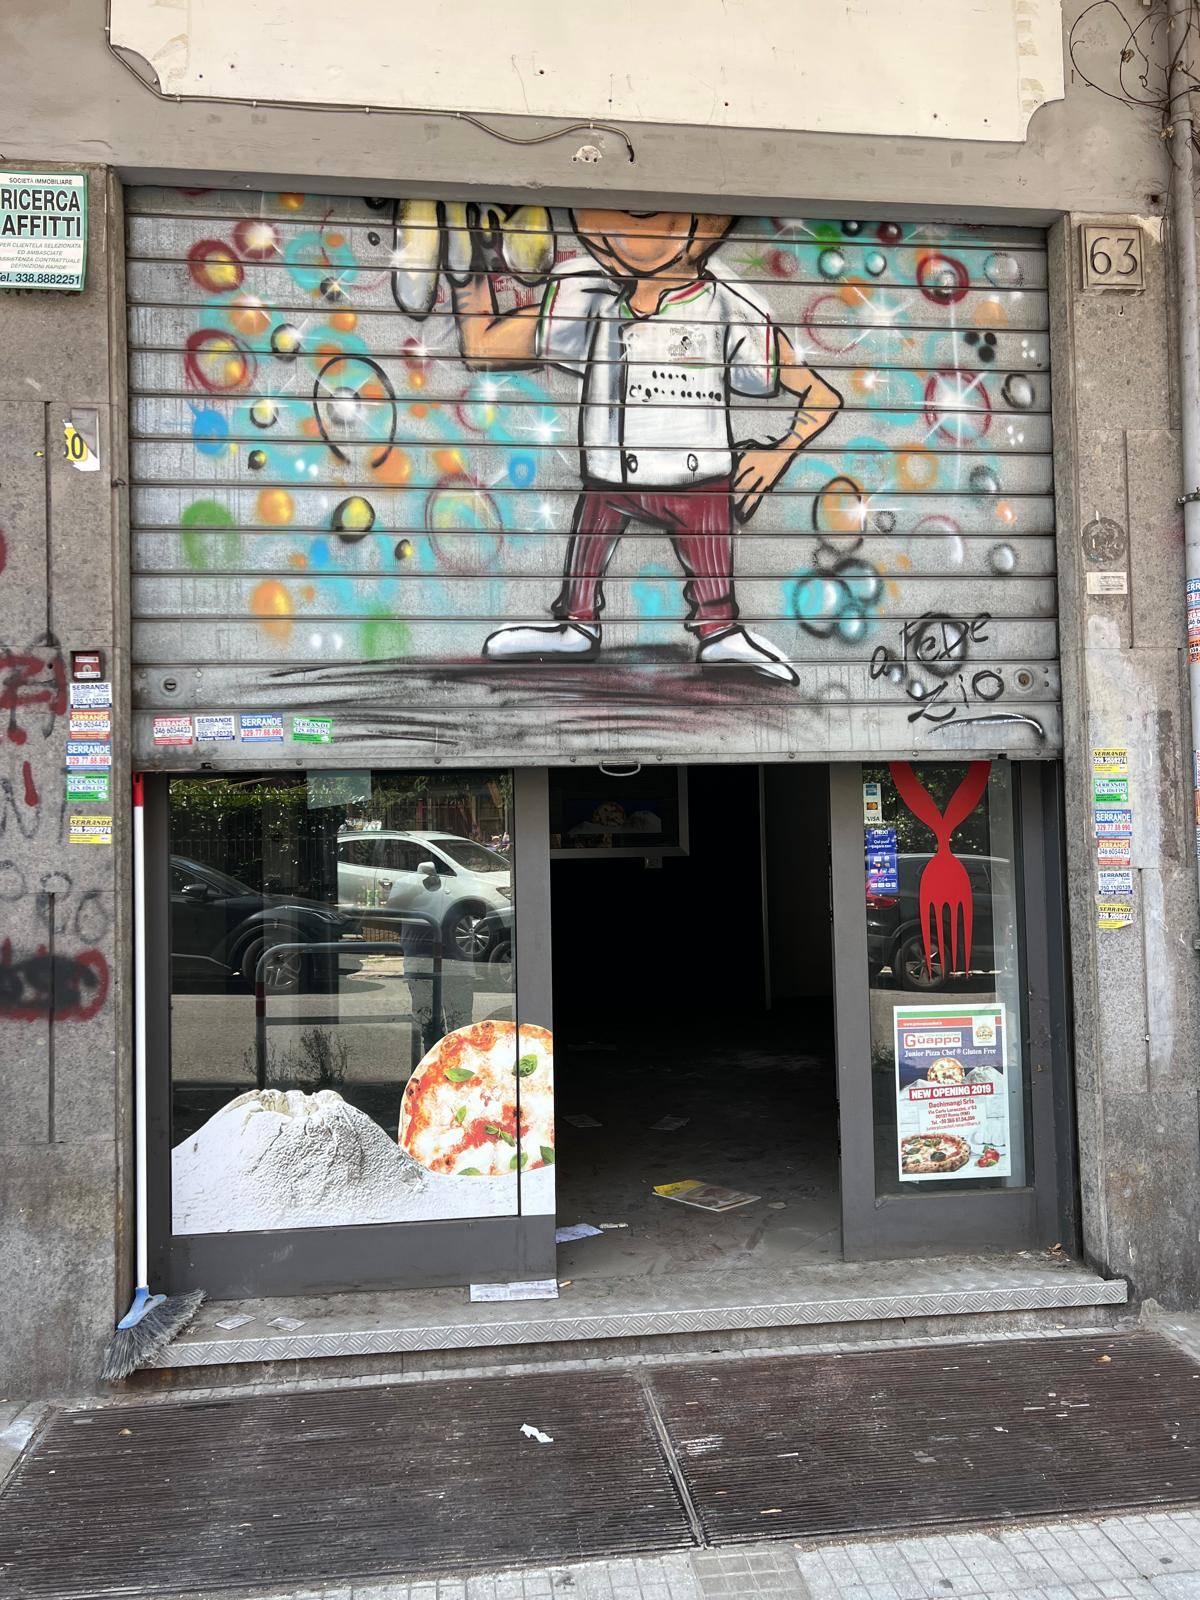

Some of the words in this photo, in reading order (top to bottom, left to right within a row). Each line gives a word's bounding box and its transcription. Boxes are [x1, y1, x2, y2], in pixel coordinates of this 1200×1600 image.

[1, 189, 80, 211] RICERCA
[1, 215, 80, 237] AFFITTI
[1090, 236, 1138, 276] 63
[16, 273, 80, 284] 338.8882251
[241, 717, 282, 726] SERRANDE
[67, 745, 110, 754] SERRANDE
[905, 1034, 961, 1047] Guappo
[911, 1089, 932, 1099] NEW
[933, 1086, 971, 1098] OPENING
[971, 1084, 991, 1094] 2019
